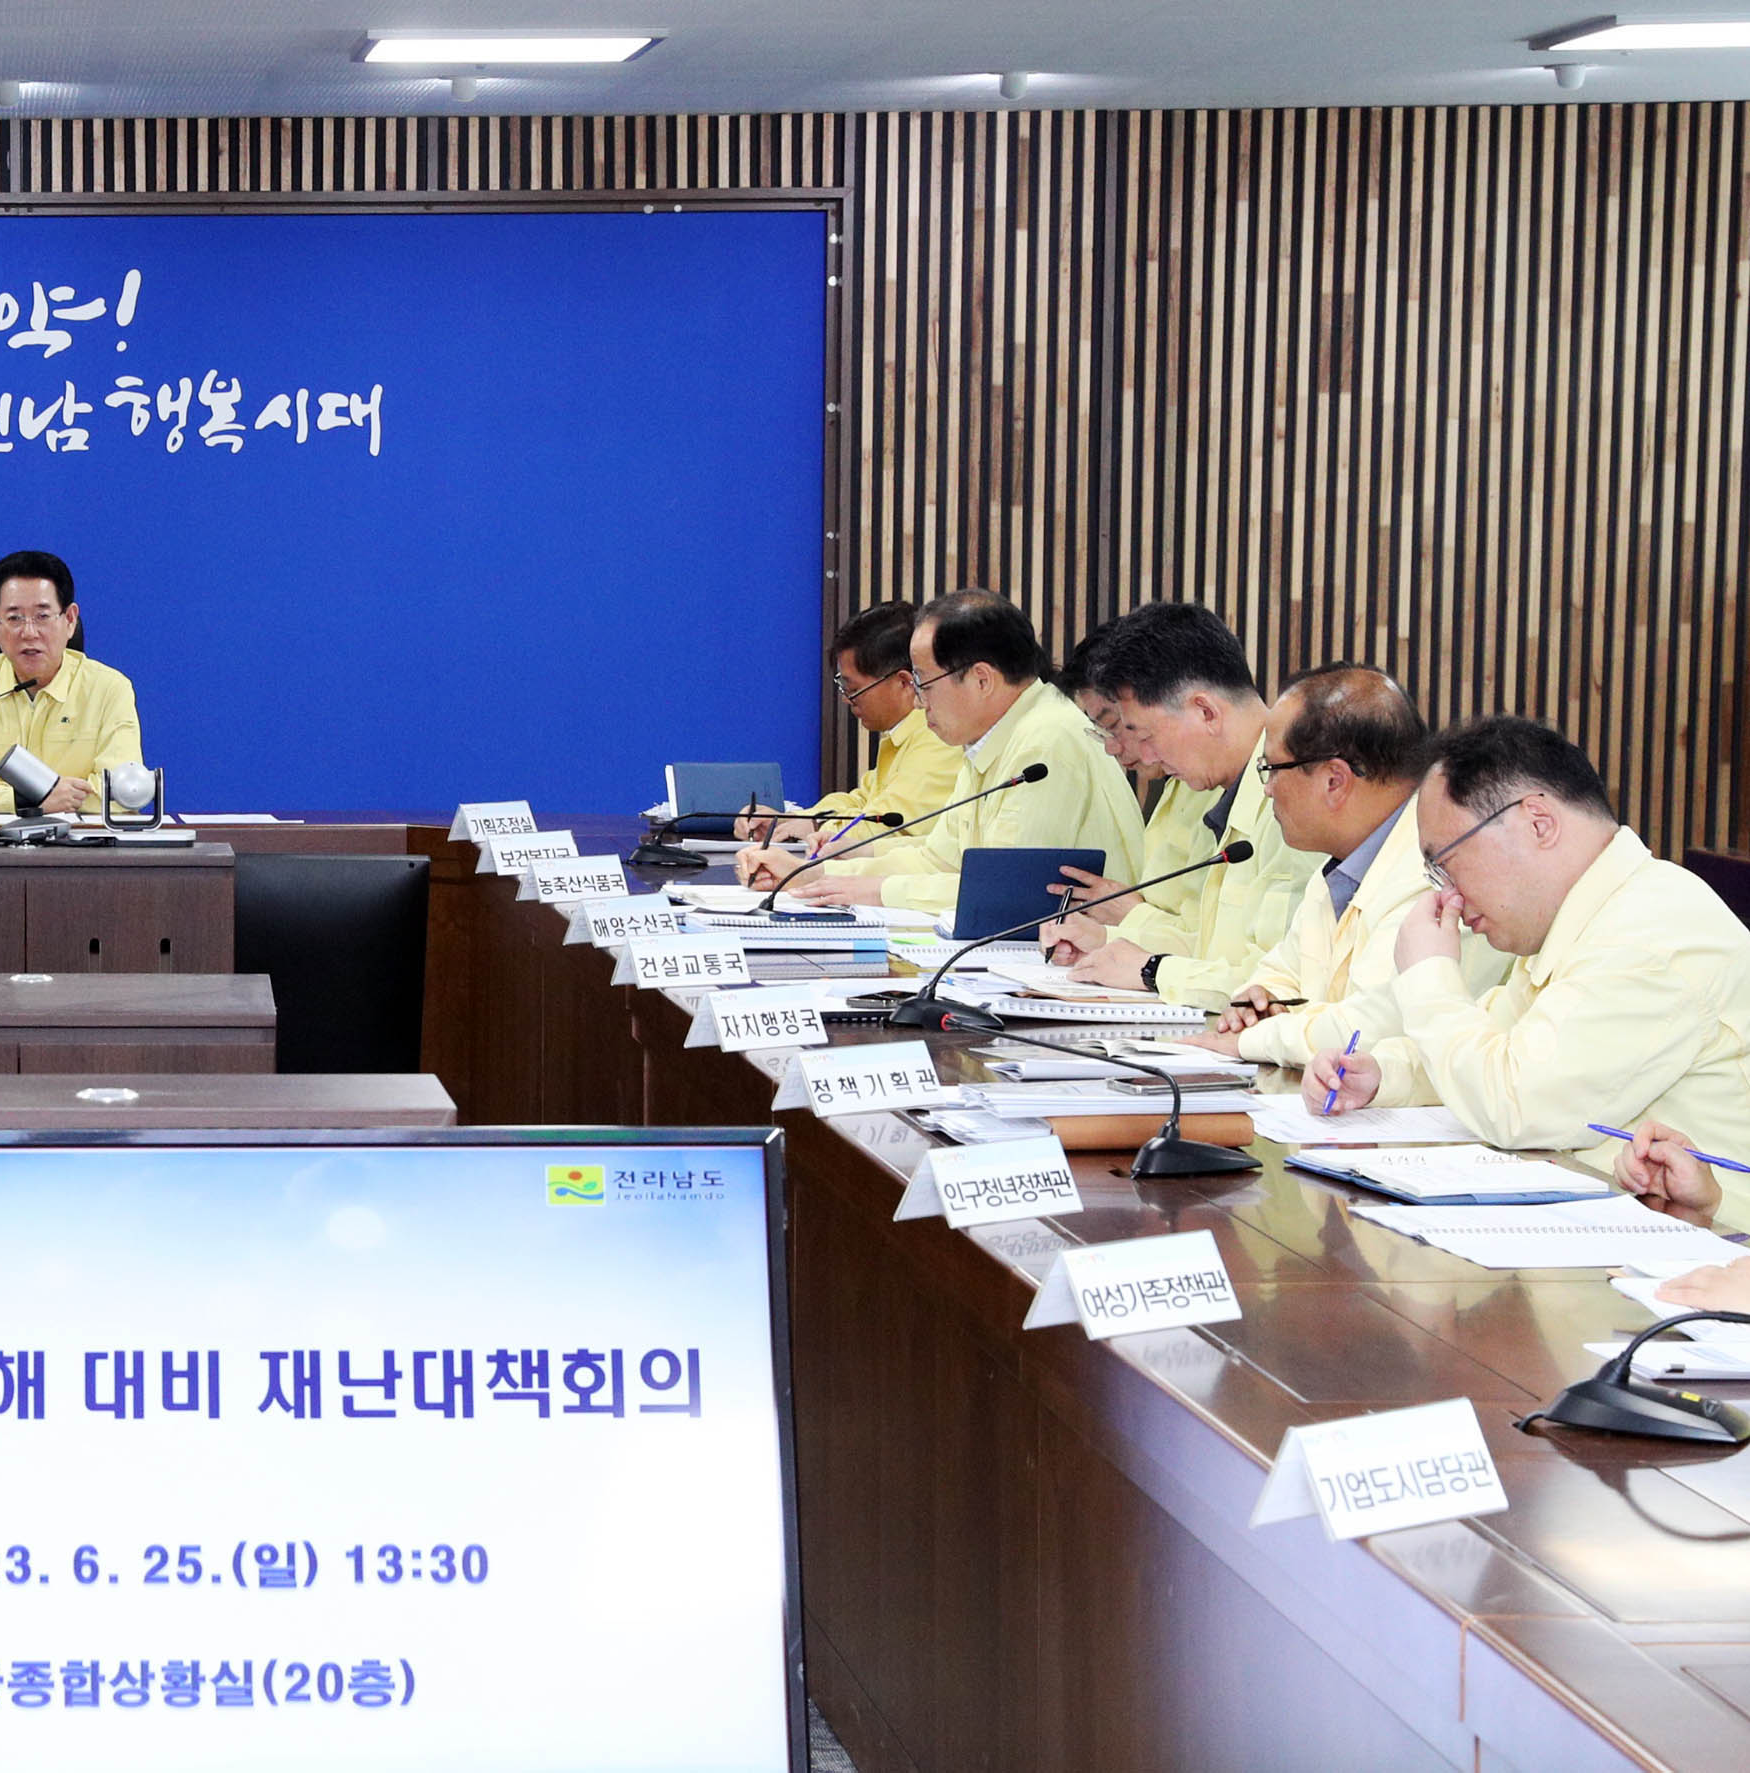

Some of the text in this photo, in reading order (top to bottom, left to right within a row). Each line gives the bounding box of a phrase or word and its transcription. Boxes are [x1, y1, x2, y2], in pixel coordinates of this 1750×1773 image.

[105, 370, 247, 454] 행복
[255, 384, 383, 457] 시대
[471, 817, 534, 835] 기획조정실
[539, 874, 626, 895] 농축산식품국
[592, 913, 674, 938] 해양수산국
[639, 952, 744, 980] 건설교통국
[720, 1009, 820, 1041] 자치행정국
[612, 1170, 725, 1189] 전라남도
[943, 1169, 1075, 1212] 인구청년정책관
[1081, 1269, 1232, 1318] 여성가족정책관
[85, 1350, 220, 1419] 대비
[257, 1348, 701, 1418] 재난대책회의
[1320, 1450, 1494, 1513] 기업도시담당관
[73, 1545, 119, 1585] 6.
[143, 1541, 319, 1588] 25.(일)
[345, 1544, 489, 1584] 13:30
